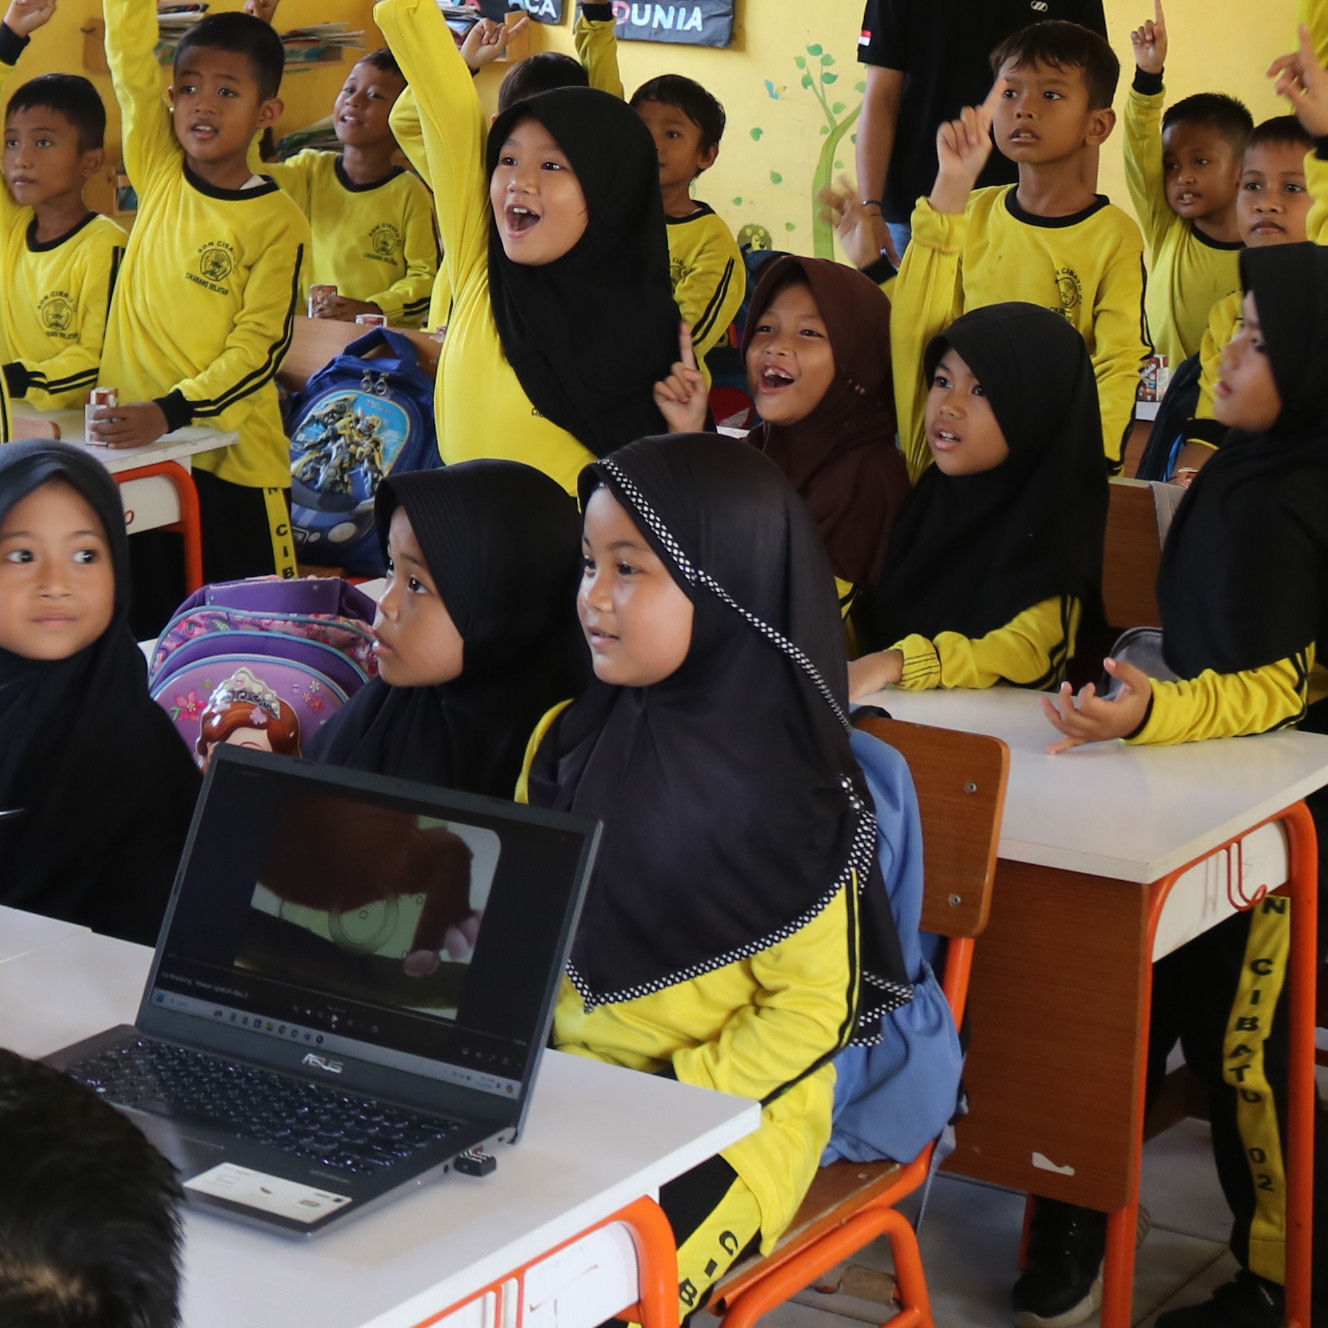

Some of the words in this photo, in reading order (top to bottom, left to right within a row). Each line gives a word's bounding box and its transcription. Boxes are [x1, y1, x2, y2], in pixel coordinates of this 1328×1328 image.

[612, 1, 703, 32] DUNIA
[302, 1053, 344, 1073] ASUS
[1248, 1147, 1275, 1192] 02
